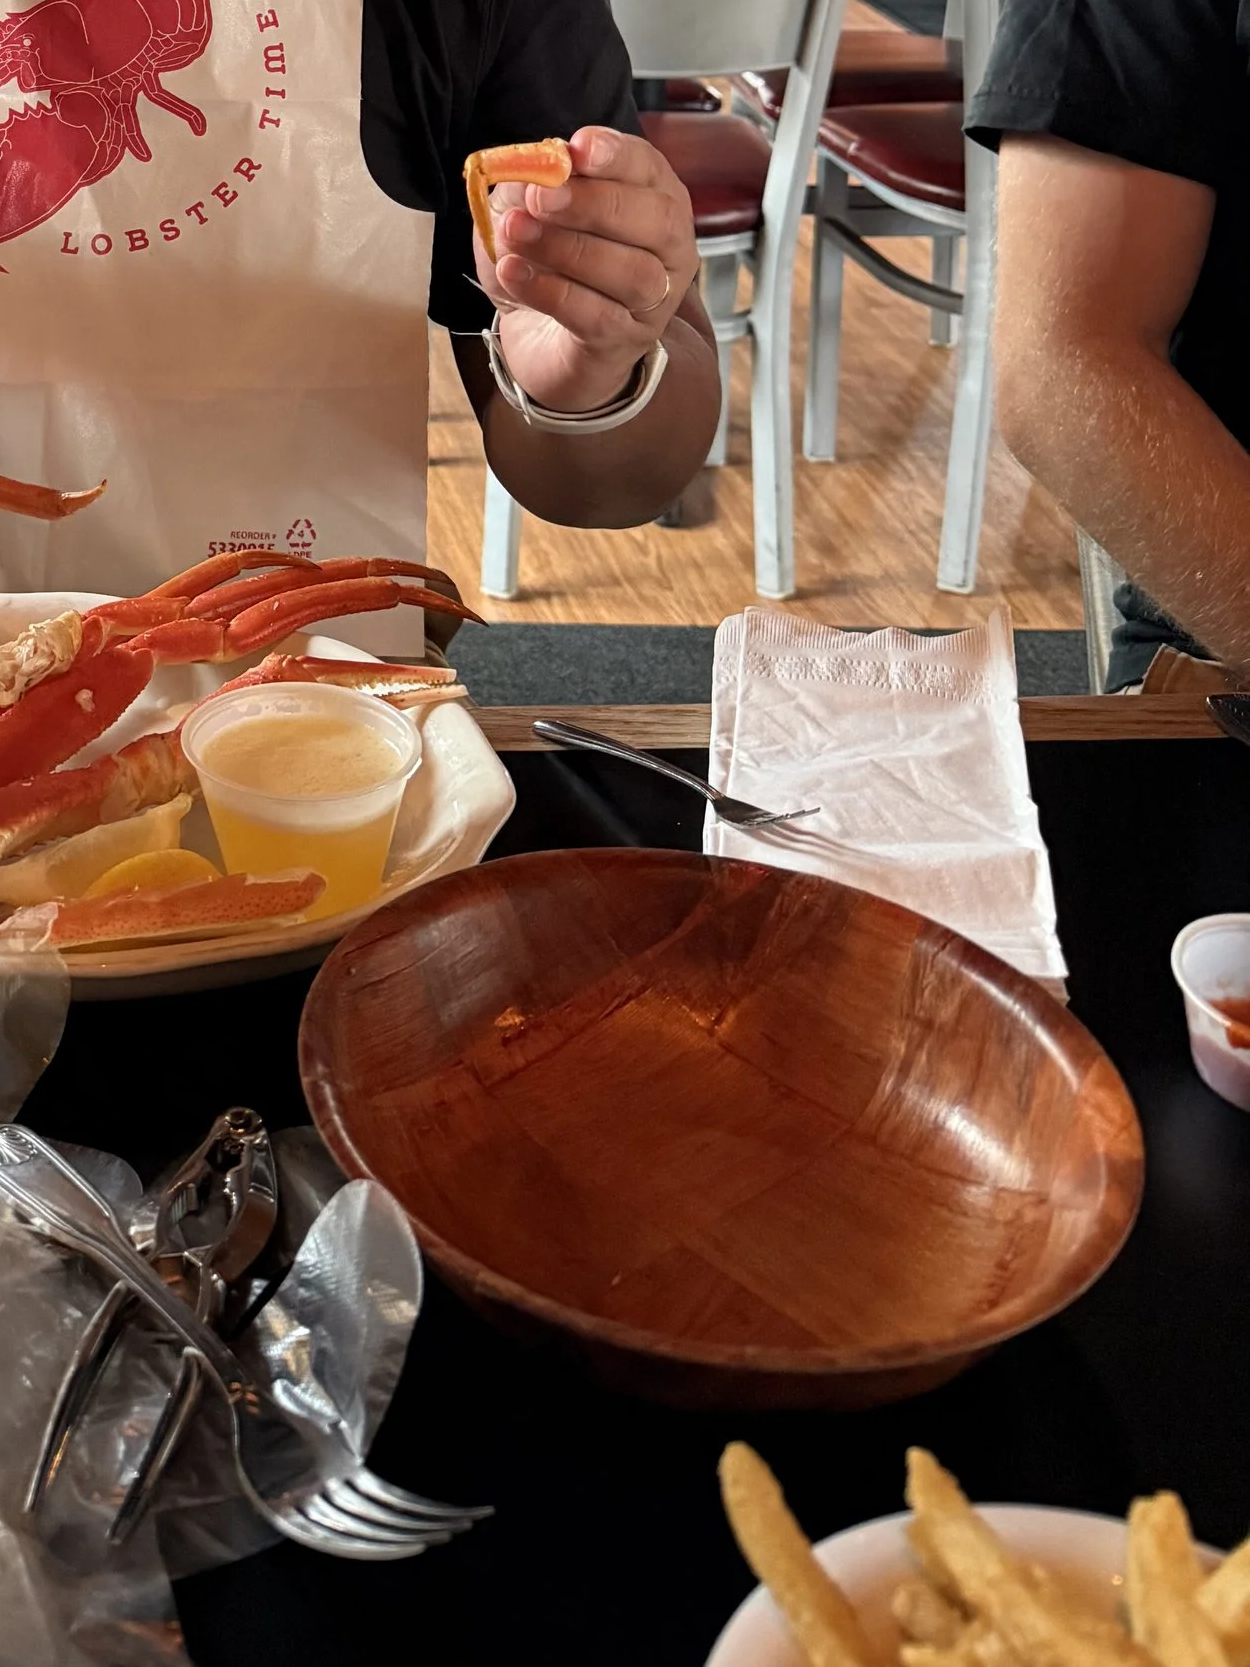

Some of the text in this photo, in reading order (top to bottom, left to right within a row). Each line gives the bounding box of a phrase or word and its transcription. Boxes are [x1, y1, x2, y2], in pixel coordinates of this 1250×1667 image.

[60, 9, 287, 256] LOBSTER TIME
[288, 551, 312, 559] DPE
